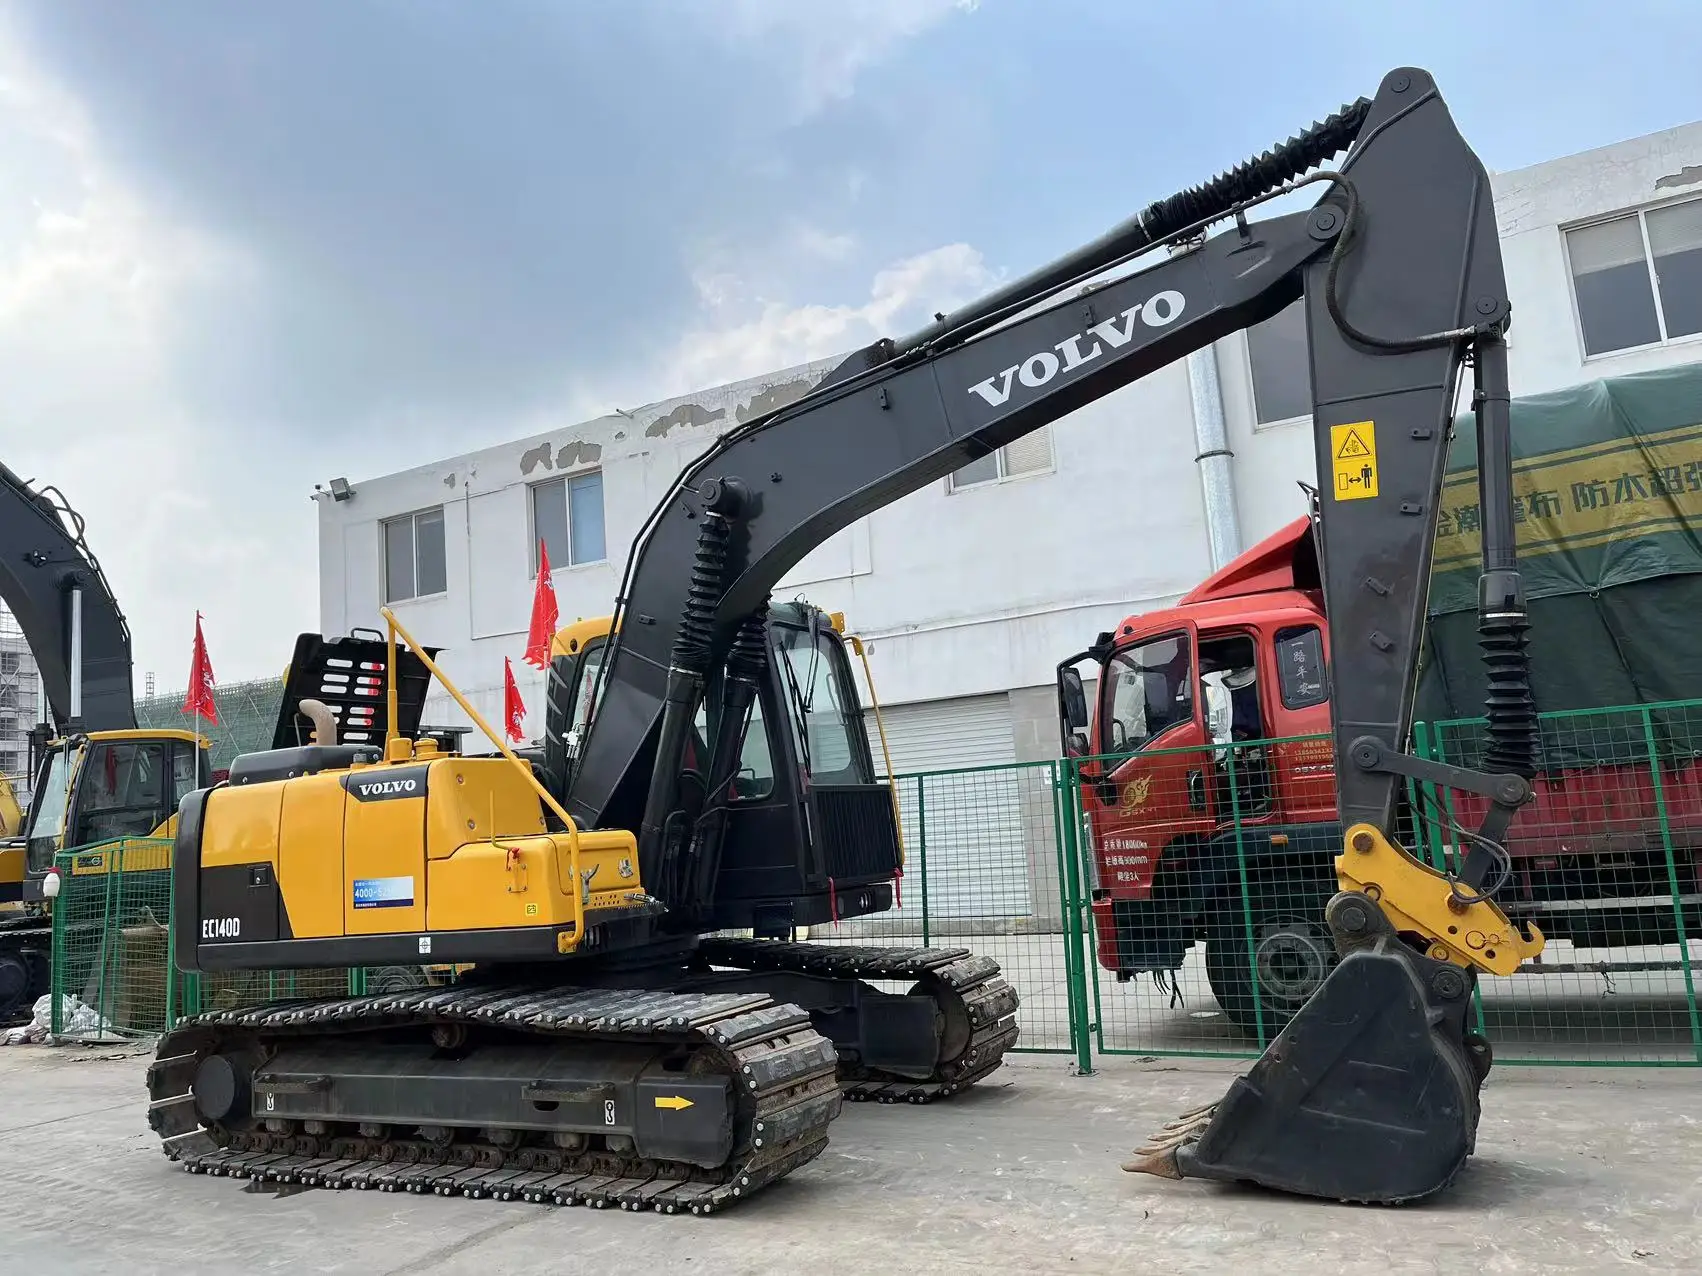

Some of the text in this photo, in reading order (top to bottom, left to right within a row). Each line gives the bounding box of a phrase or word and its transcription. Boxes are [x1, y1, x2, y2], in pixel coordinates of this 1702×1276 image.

[967, 290, 1186, 407] VOLVO
[359, 779, 417, 796] VOLVO
[202, 917, 240, 938] EC140D
